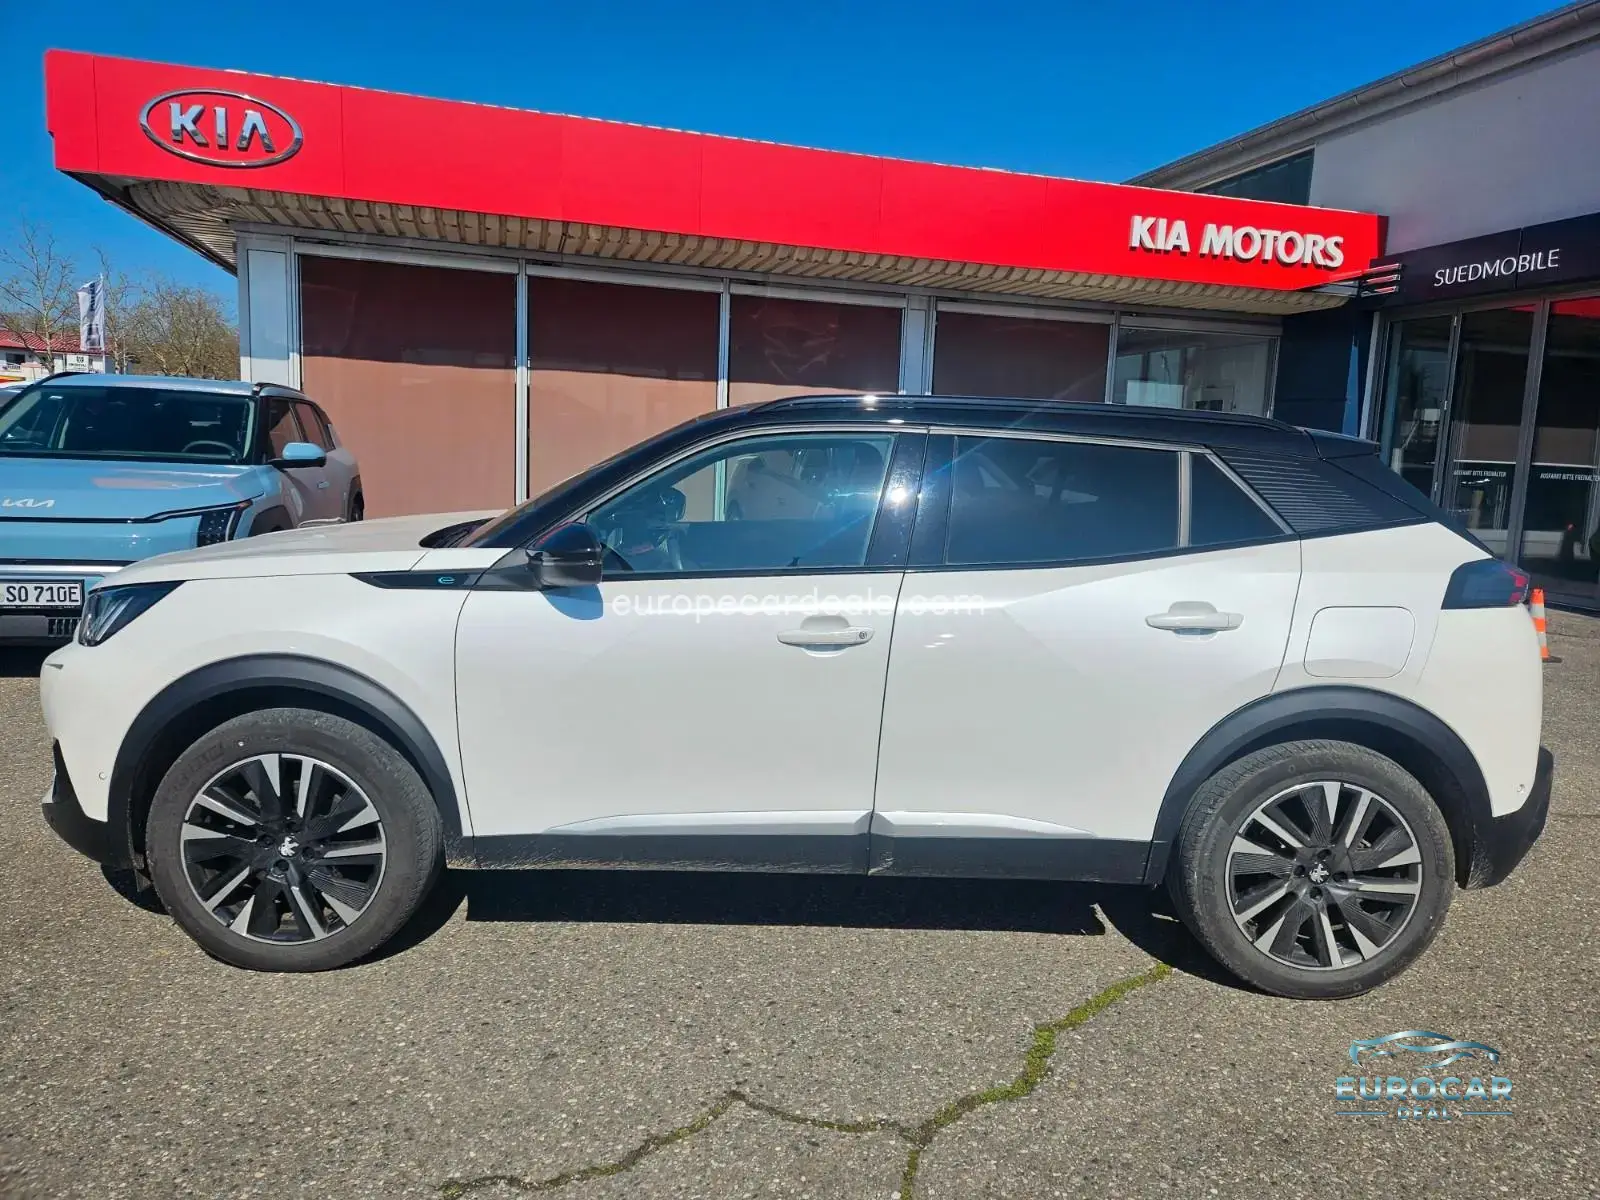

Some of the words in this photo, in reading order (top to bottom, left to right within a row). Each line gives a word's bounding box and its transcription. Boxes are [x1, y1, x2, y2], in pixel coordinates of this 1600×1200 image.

[169, 102, 275, 152] KIA
[1130, 215, 1191, 254] KIA
[1200, 223, 1345, 268] MOTORS
[1433, 248, 1560, 287] SUEDMOBILE
[33, 586, 80, 603] 710E
